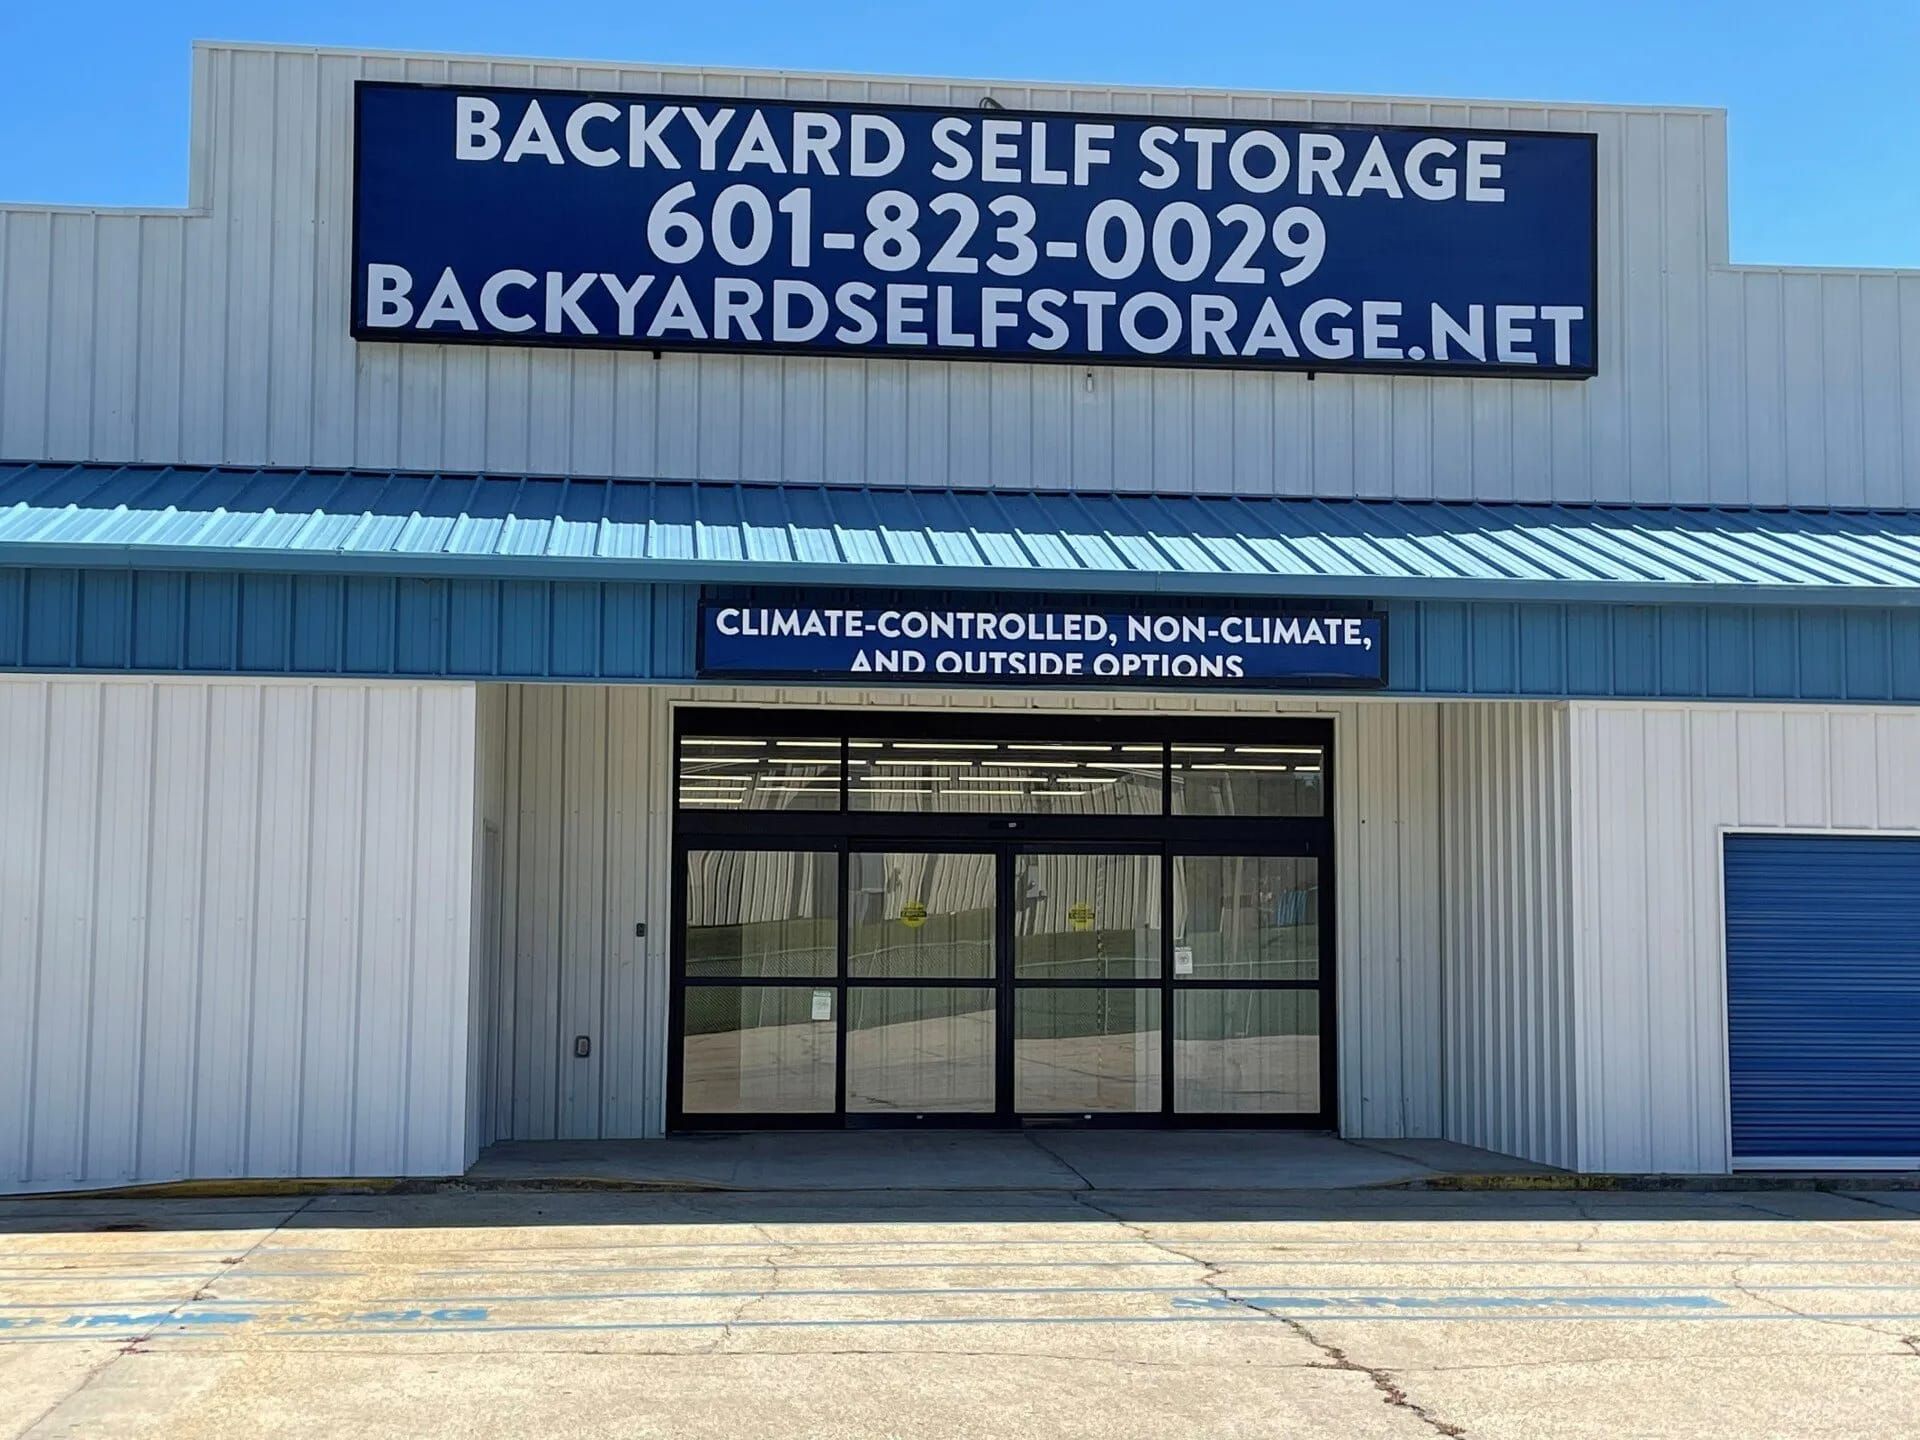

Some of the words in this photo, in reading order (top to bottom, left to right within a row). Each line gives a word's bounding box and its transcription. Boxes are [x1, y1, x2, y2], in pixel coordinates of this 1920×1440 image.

[457, 96, 905, 177] BACKYARD
[931, 117, 1115, 186] SELF
[1139, 126, 1506, 202] STORAGE
[647, 181, 1326, 287] 601-823-0029
[366, 263, 1584, 367] BACKYARDSELFSTORAGE.NET
[716, 607, 1118, 647] CLIMATE-CONTROLLED,
[1128, 615, 1372, 651] NON-CLIMATE,
[850, 649, 926, 673] AND
[935, 650, 1084, 676] OUTSIDE
[1093, 653, 1244, 678] OPTIONS
